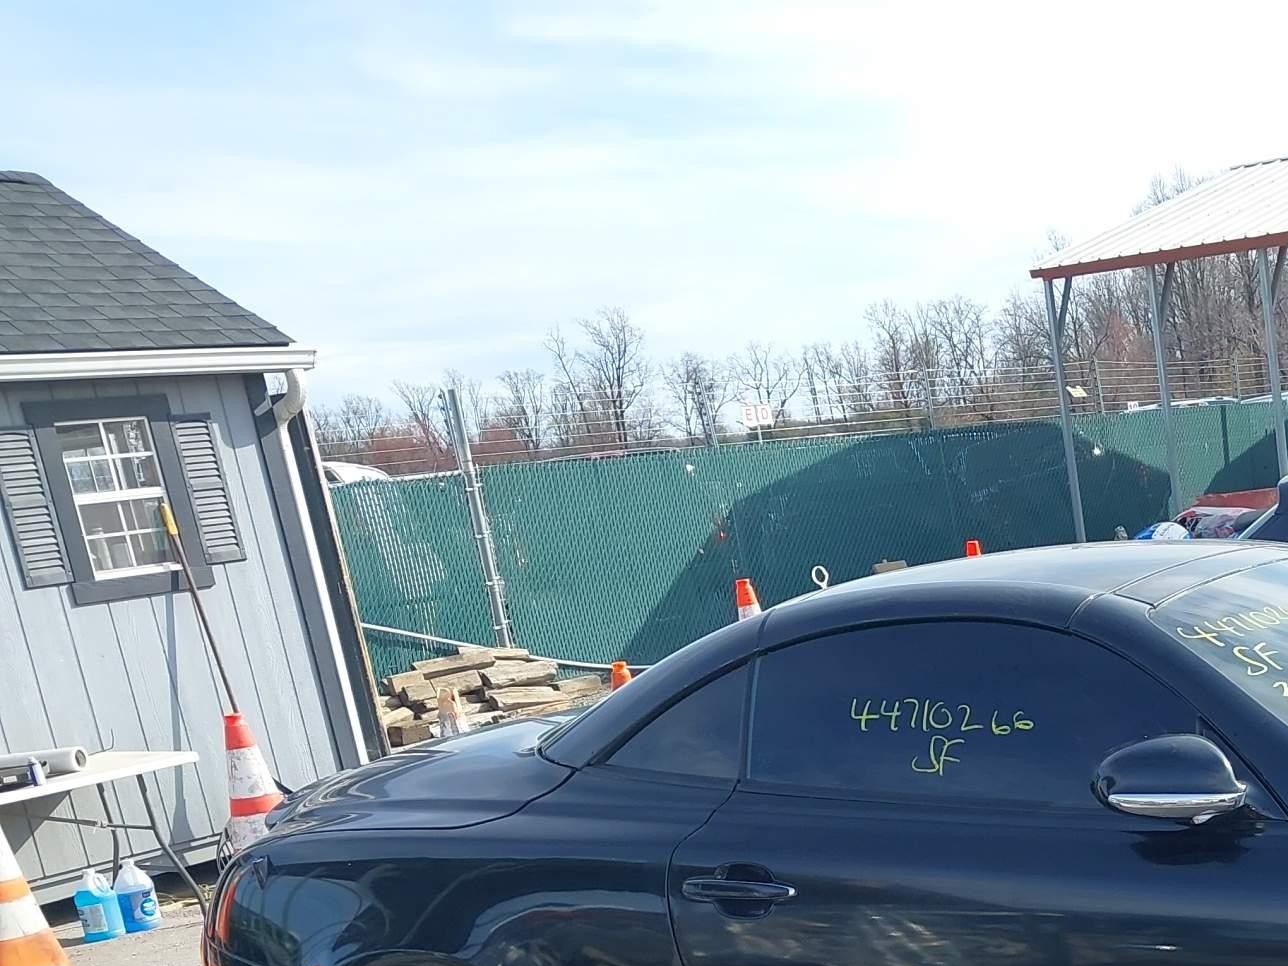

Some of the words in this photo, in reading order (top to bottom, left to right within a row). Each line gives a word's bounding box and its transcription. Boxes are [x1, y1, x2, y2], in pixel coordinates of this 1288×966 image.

[1232, 642, 1284, 676] SF
[851, 698, 1034, 734] 44710266
[911, 735, 966, 776] SF
